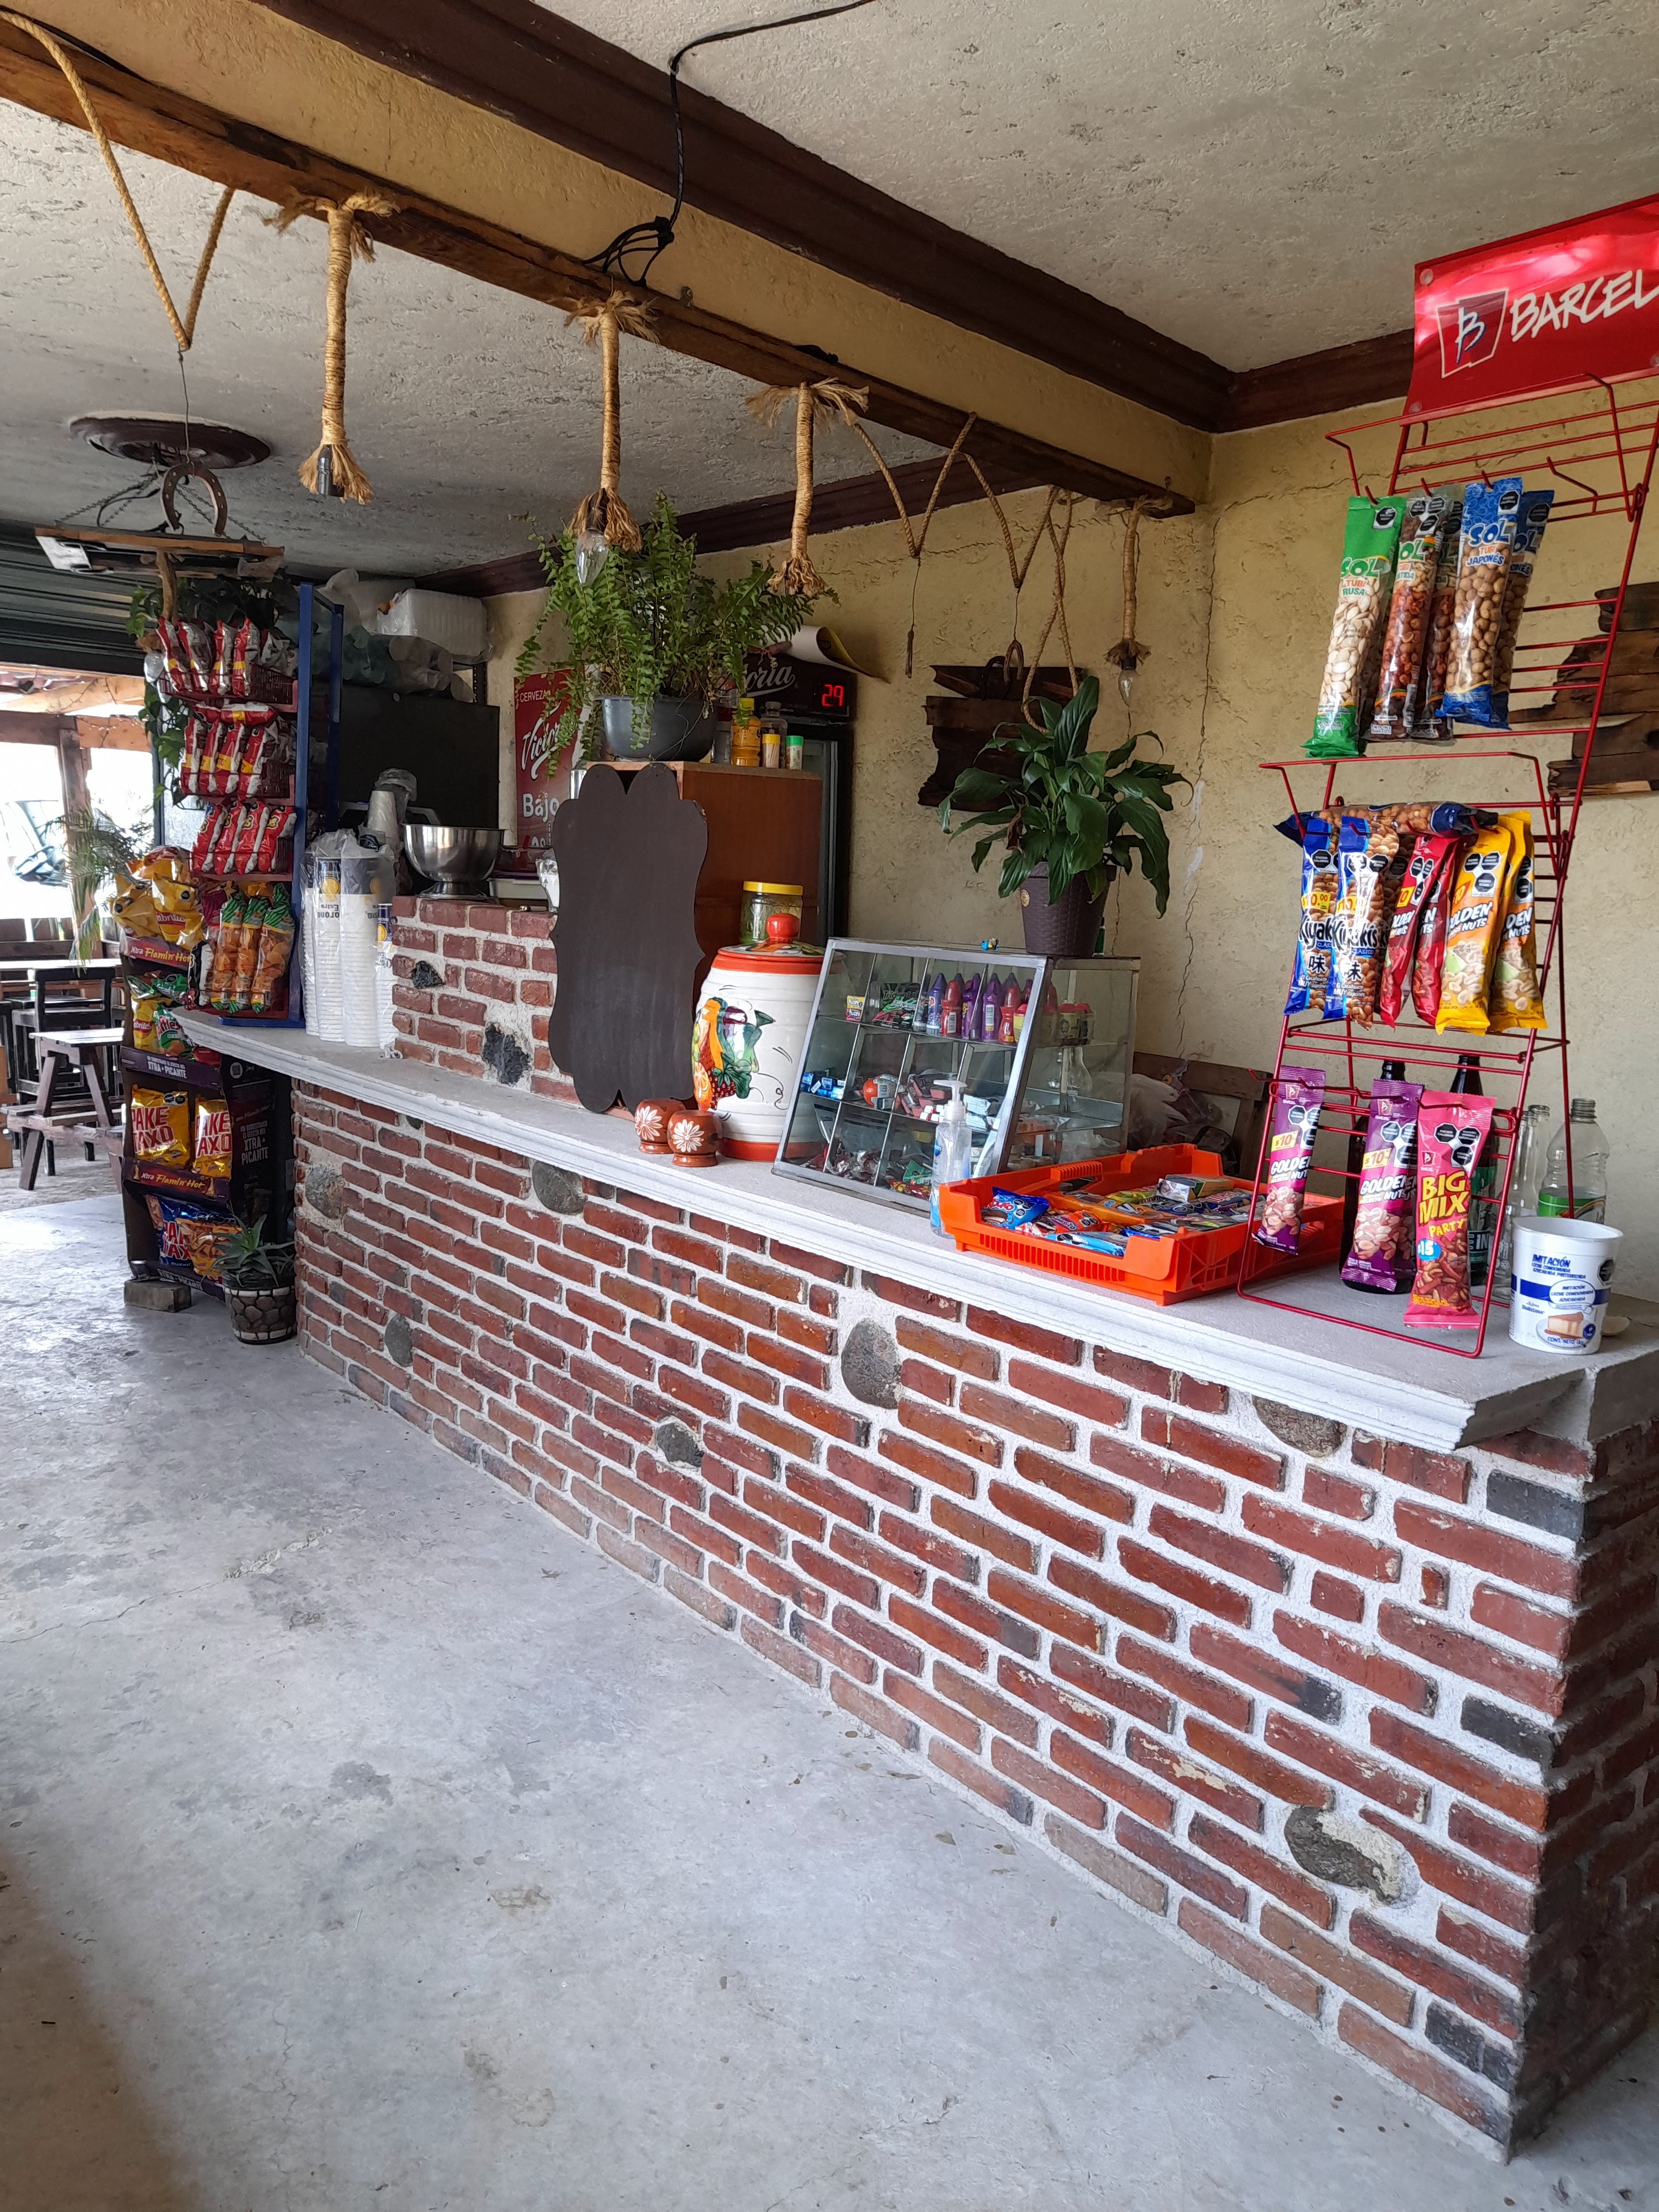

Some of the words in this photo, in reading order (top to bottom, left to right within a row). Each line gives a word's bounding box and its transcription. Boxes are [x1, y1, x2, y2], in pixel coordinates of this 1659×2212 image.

[1510, 269, 1659, 342] BARCEL
[1469, 518, 1510, 547] SOL
[1399, 539, 1428, 562] OL
[1513, 530, 1538, 554] OL
[1340, 557, 1380, 579] SOL
[1467, 552, 1505, 566] JAPONÉS
[1342, 588, 1365, 596] RUSA
[1345, 580, 1366, 588] TUBI
[747, 665, 795, 697] oria
[520, 690, 551, 703] CERVEZA
[822, 684, 844, 708] 29
[521, 699, 564, 780] Victor
[523, 793, 560, 823] Bajo
[156, 911, 186, 923] abritas
[1392, 910, 1415, 928] OLDEN
[1462, 916, 1488, 932] NUTS
[1506, 907, 1533, 929] DEN
[1300, 914, 1333, 950] Kiyak
[1421, 923, 1434, 935] TS
[131, 946, 143, 955] Xtra
[1308, 954, 1327, 973] 味
[134, 1021, 152, 1030] abritas
[156, 1015, 181, 1036] ffles
[164, 1065, 187, 1079] PICANTE
[1275, 1134, 1292, 1146] $10
[1364, 1150, 1384, 1165] $10
[187, 1180, 206, 1188] Hot
[1291, 1170, 1308, 1180] NUT
[1422, 1171, 1467, 1202] BIG
[1419, 1191, 1469, 1225] MIX
[1428, 1218, 1465, 1238] PARTY
[1532, 1254, 1571, 1268] IMITACIÓN
